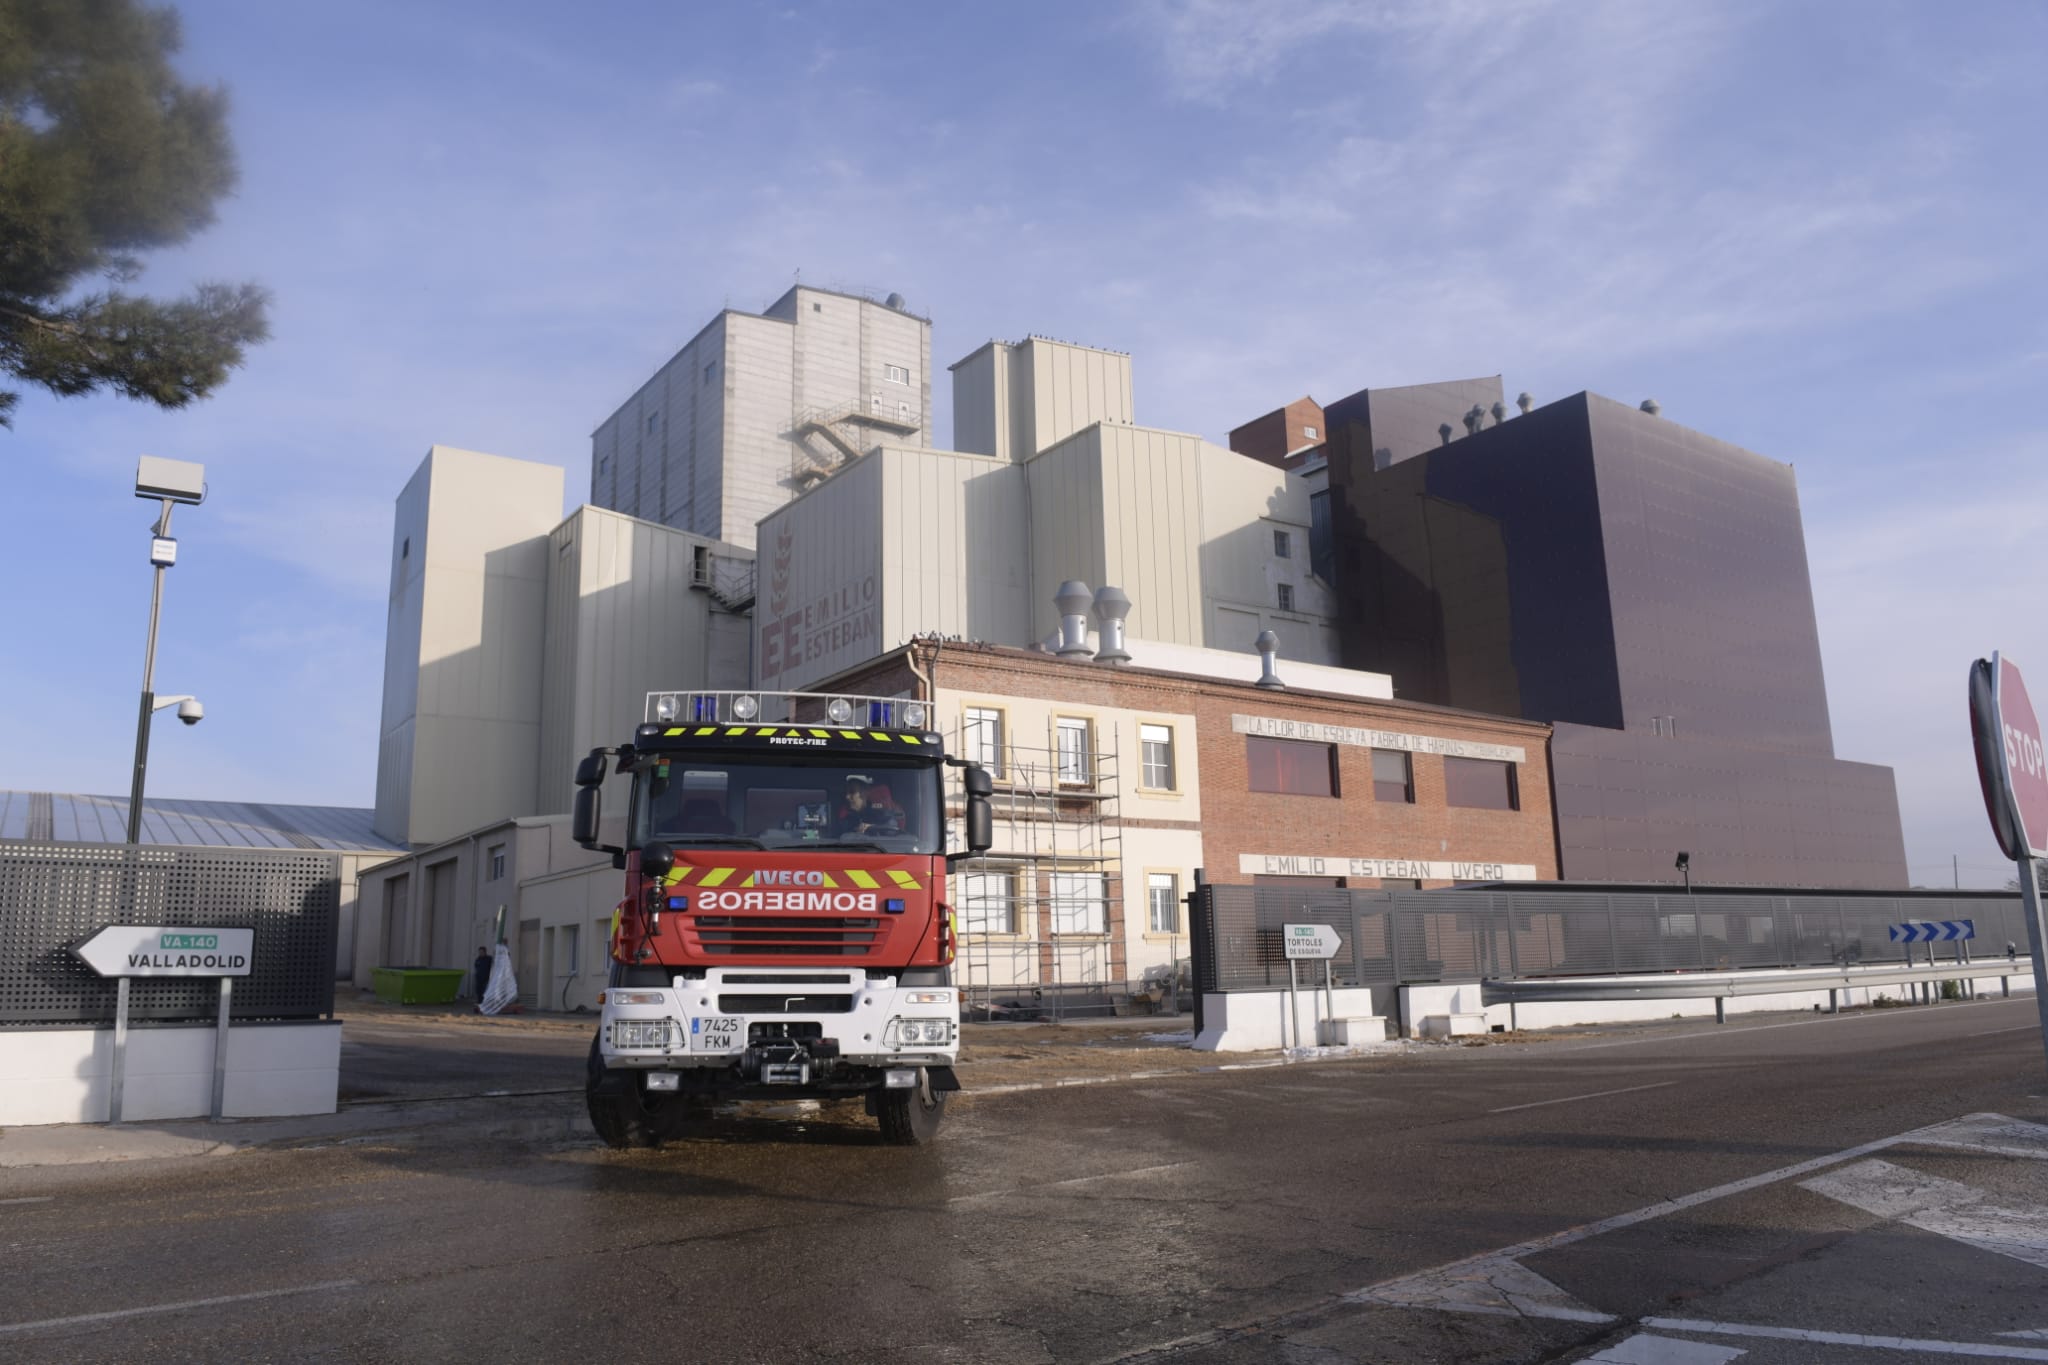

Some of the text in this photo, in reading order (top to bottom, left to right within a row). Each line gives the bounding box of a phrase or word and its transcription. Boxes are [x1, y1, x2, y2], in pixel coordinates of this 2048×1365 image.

[804, 575, 875, 630] EMILIO
[761, 610, 802, 681] EE
[805, 610, 875, 662] ESTEBAN
[769, 737, 828, 746] PROTEC-FIRE
[1248, 718, 1262, 733] LA
[1267, 719, 1295, 737] FLOR
[1299, 722, 1320, 739] DEL
[1412, 735, 1424, 752] DE
[2005, 723, 2043, 780] STOP
[753, 870, 824, 886] IVECO
[1265, 856, 1504, 880] EMILIO ESTEBAN UVERO
[163, 935, 216, 948] VA-140
[128, 954, 245, 968] VALLADOLID
[704, 1019, 738, 1032] 7425
[705, 1035, 730, 1049] FKM
